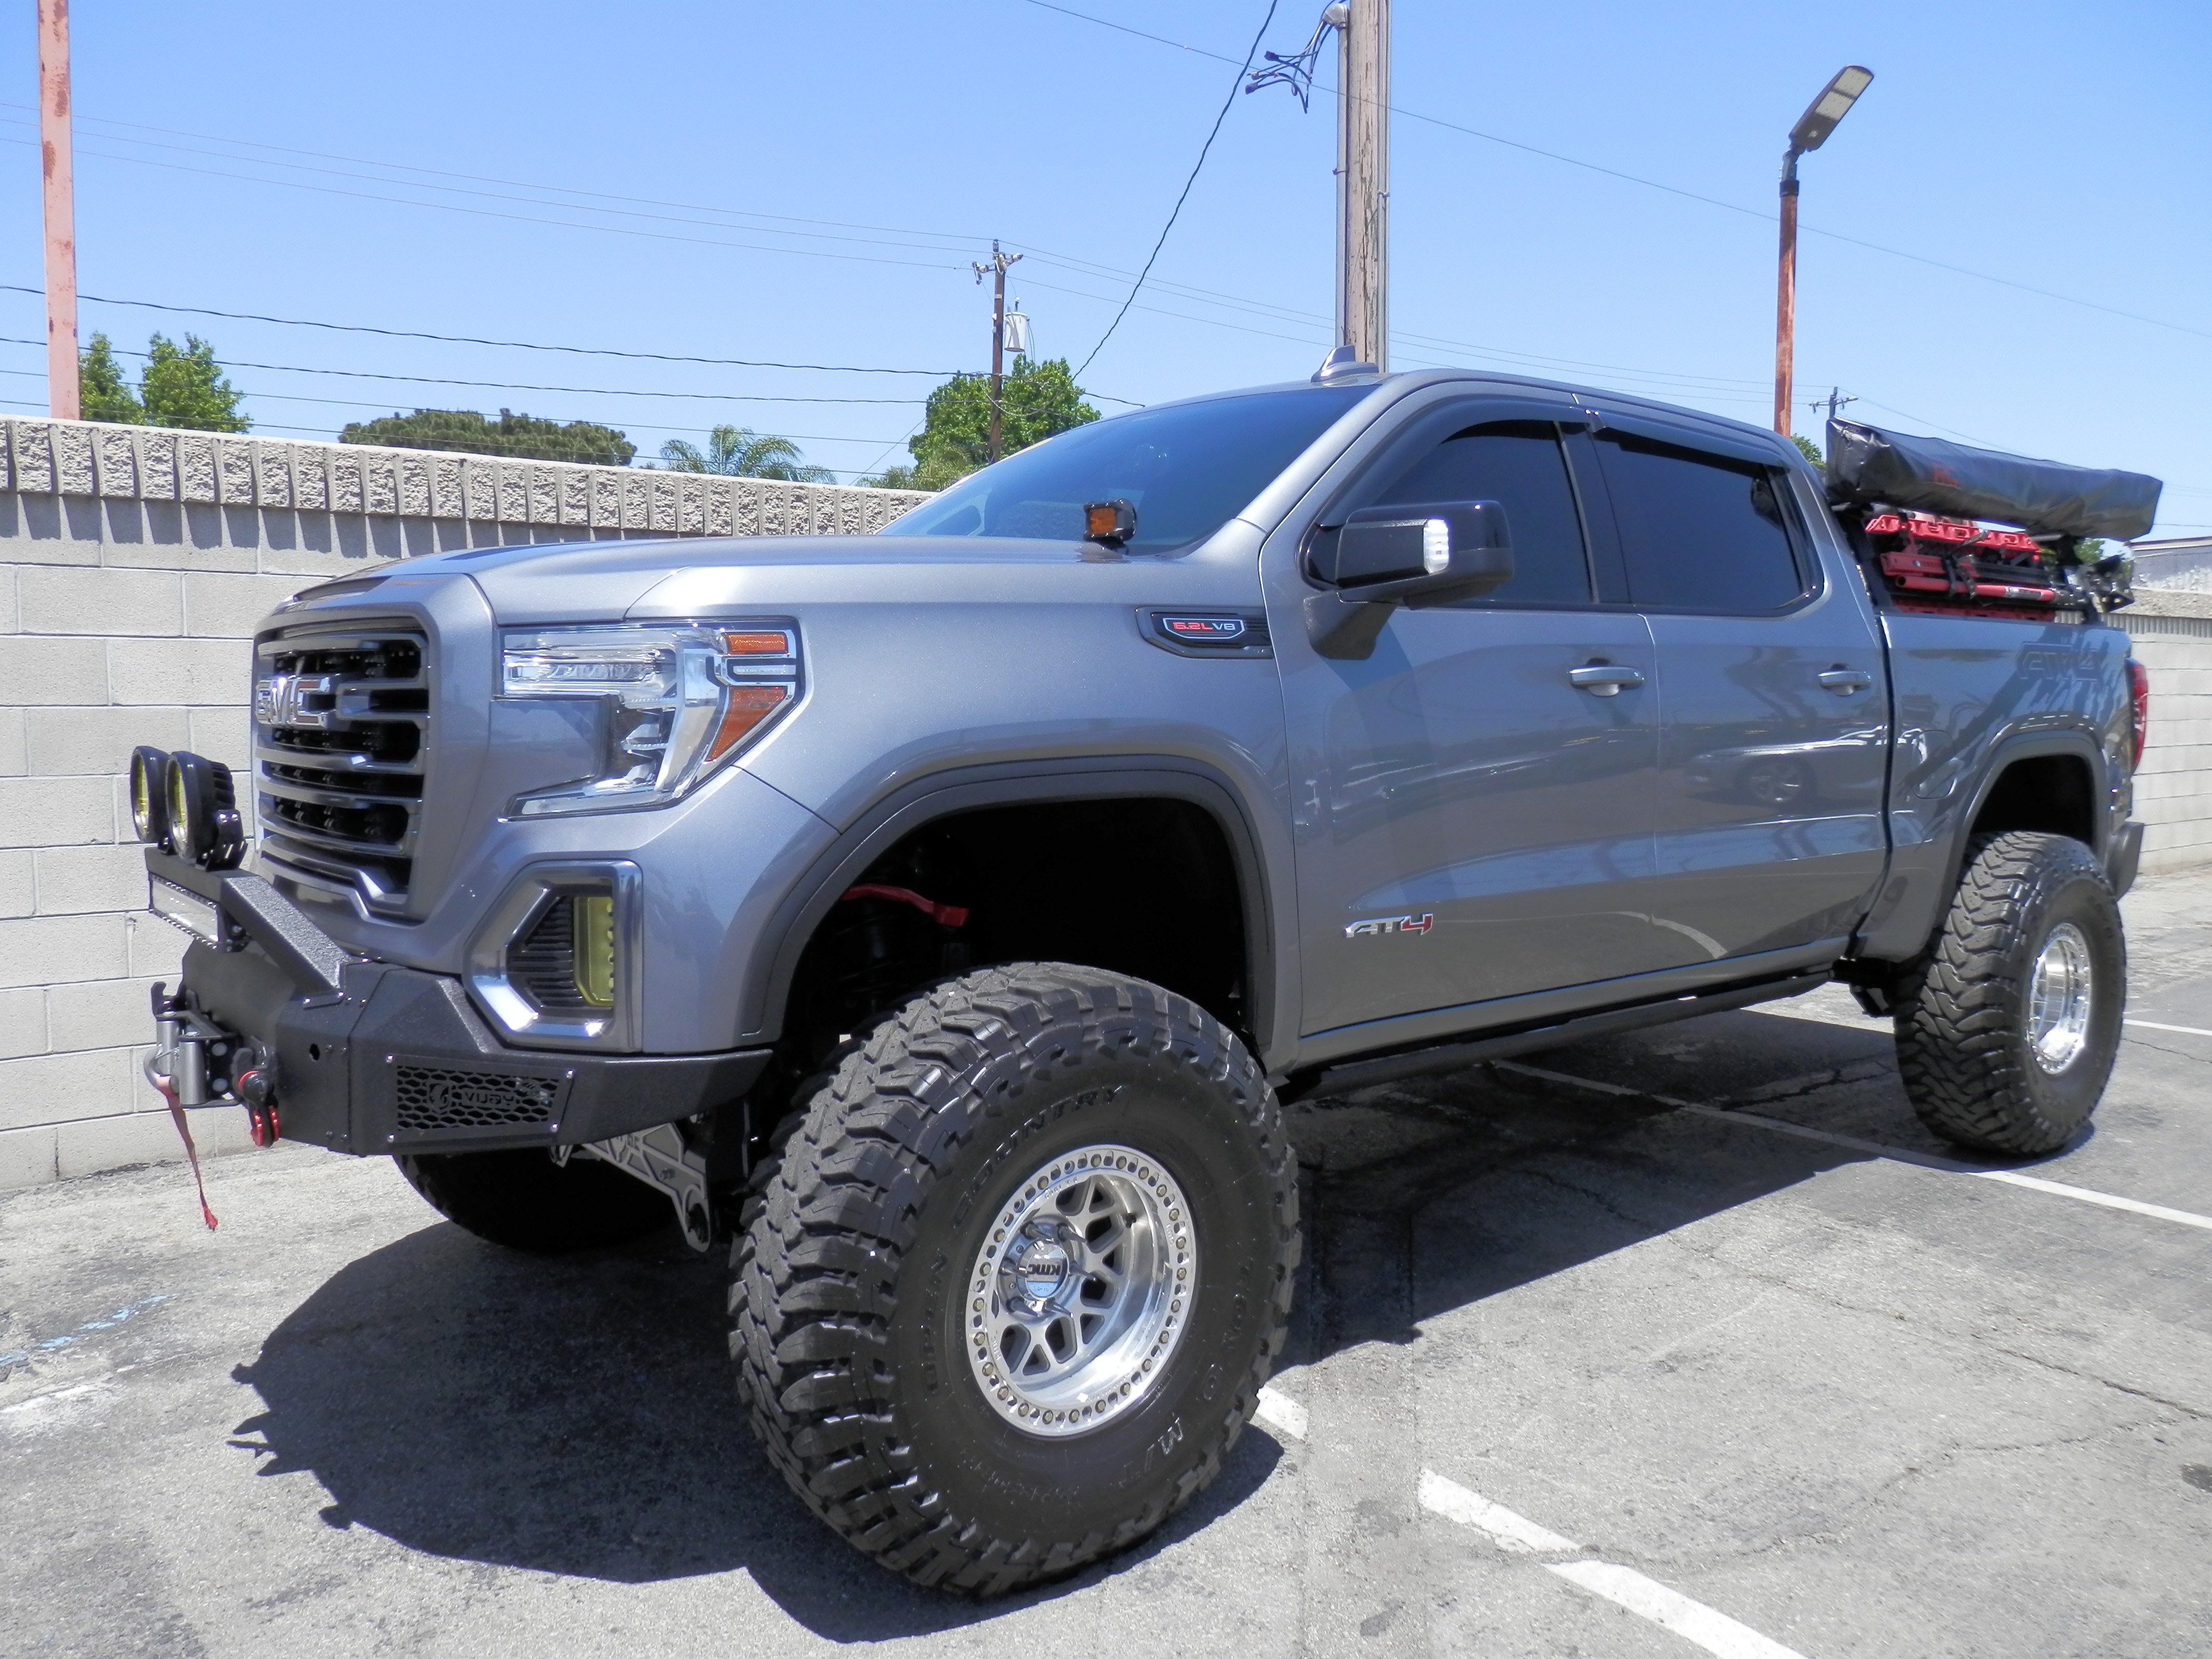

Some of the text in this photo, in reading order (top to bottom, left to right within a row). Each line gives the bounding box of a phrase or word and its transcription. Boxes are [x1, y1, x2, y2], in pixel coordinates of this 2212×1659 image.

[255, 676, 331, 726] GMC
[1345, 913, 1433, 938] AT4
[951, 1085, 1124, 1230] COUNTRY
